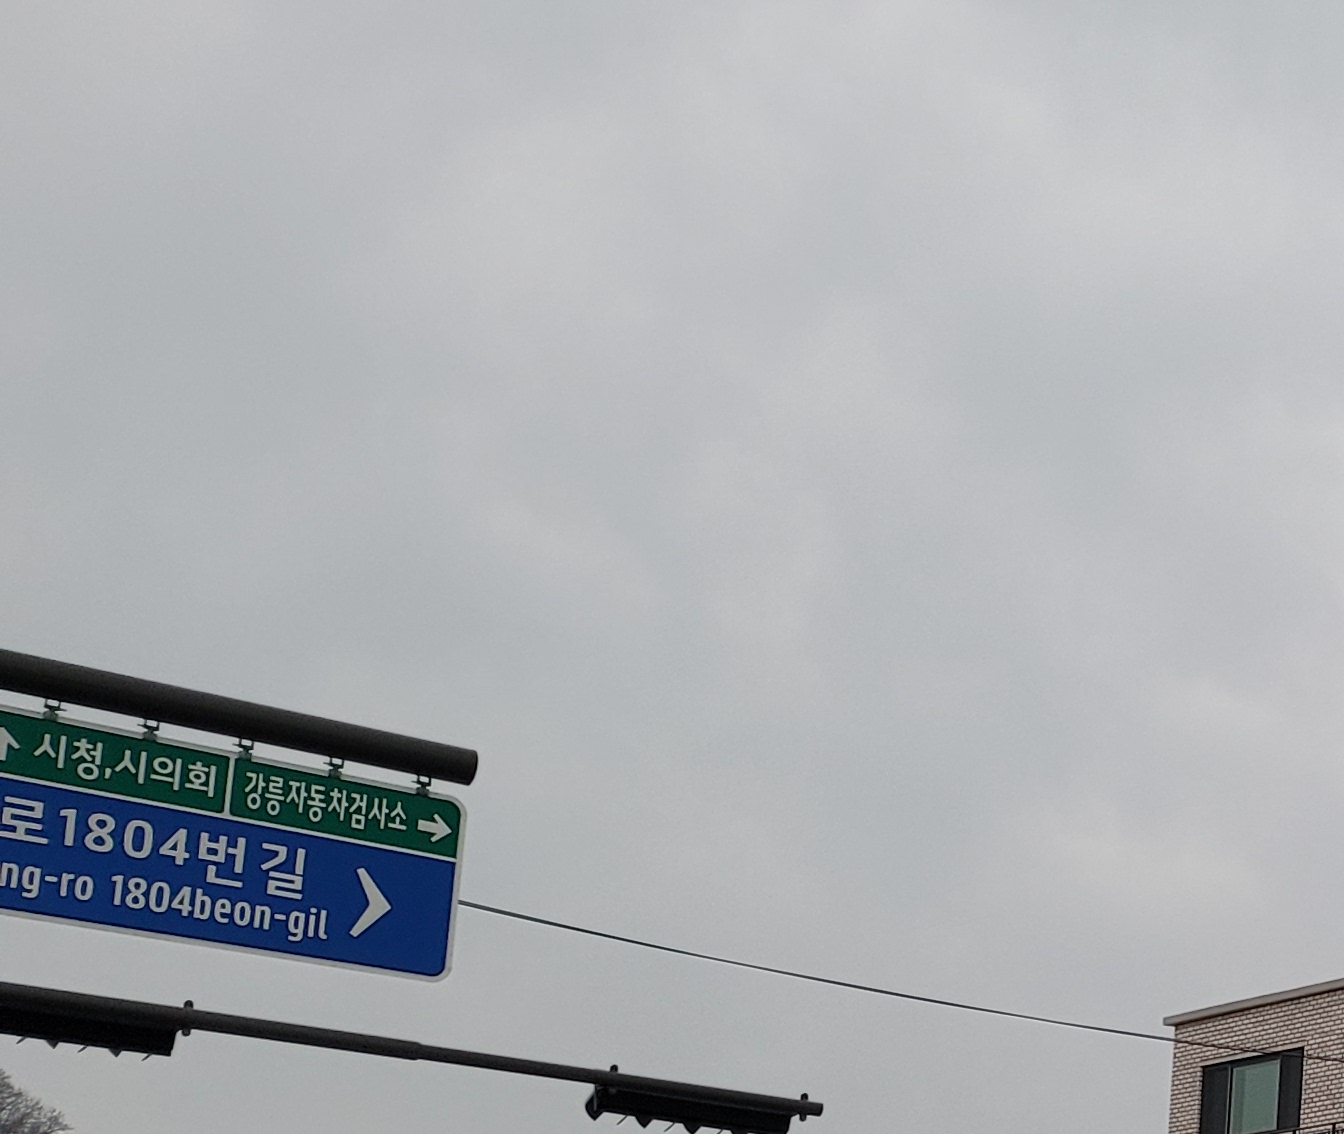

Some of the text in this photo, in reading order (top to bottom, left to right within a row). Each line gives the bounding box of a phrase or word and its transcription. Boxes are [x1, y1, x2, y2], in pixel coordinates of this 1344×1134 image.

[33, 733, 218, 798] 시청,시의회
[244, 771, 408, 831] 강릉자동차검사소
[110, 873, 328, 942] 1804beon-gil
